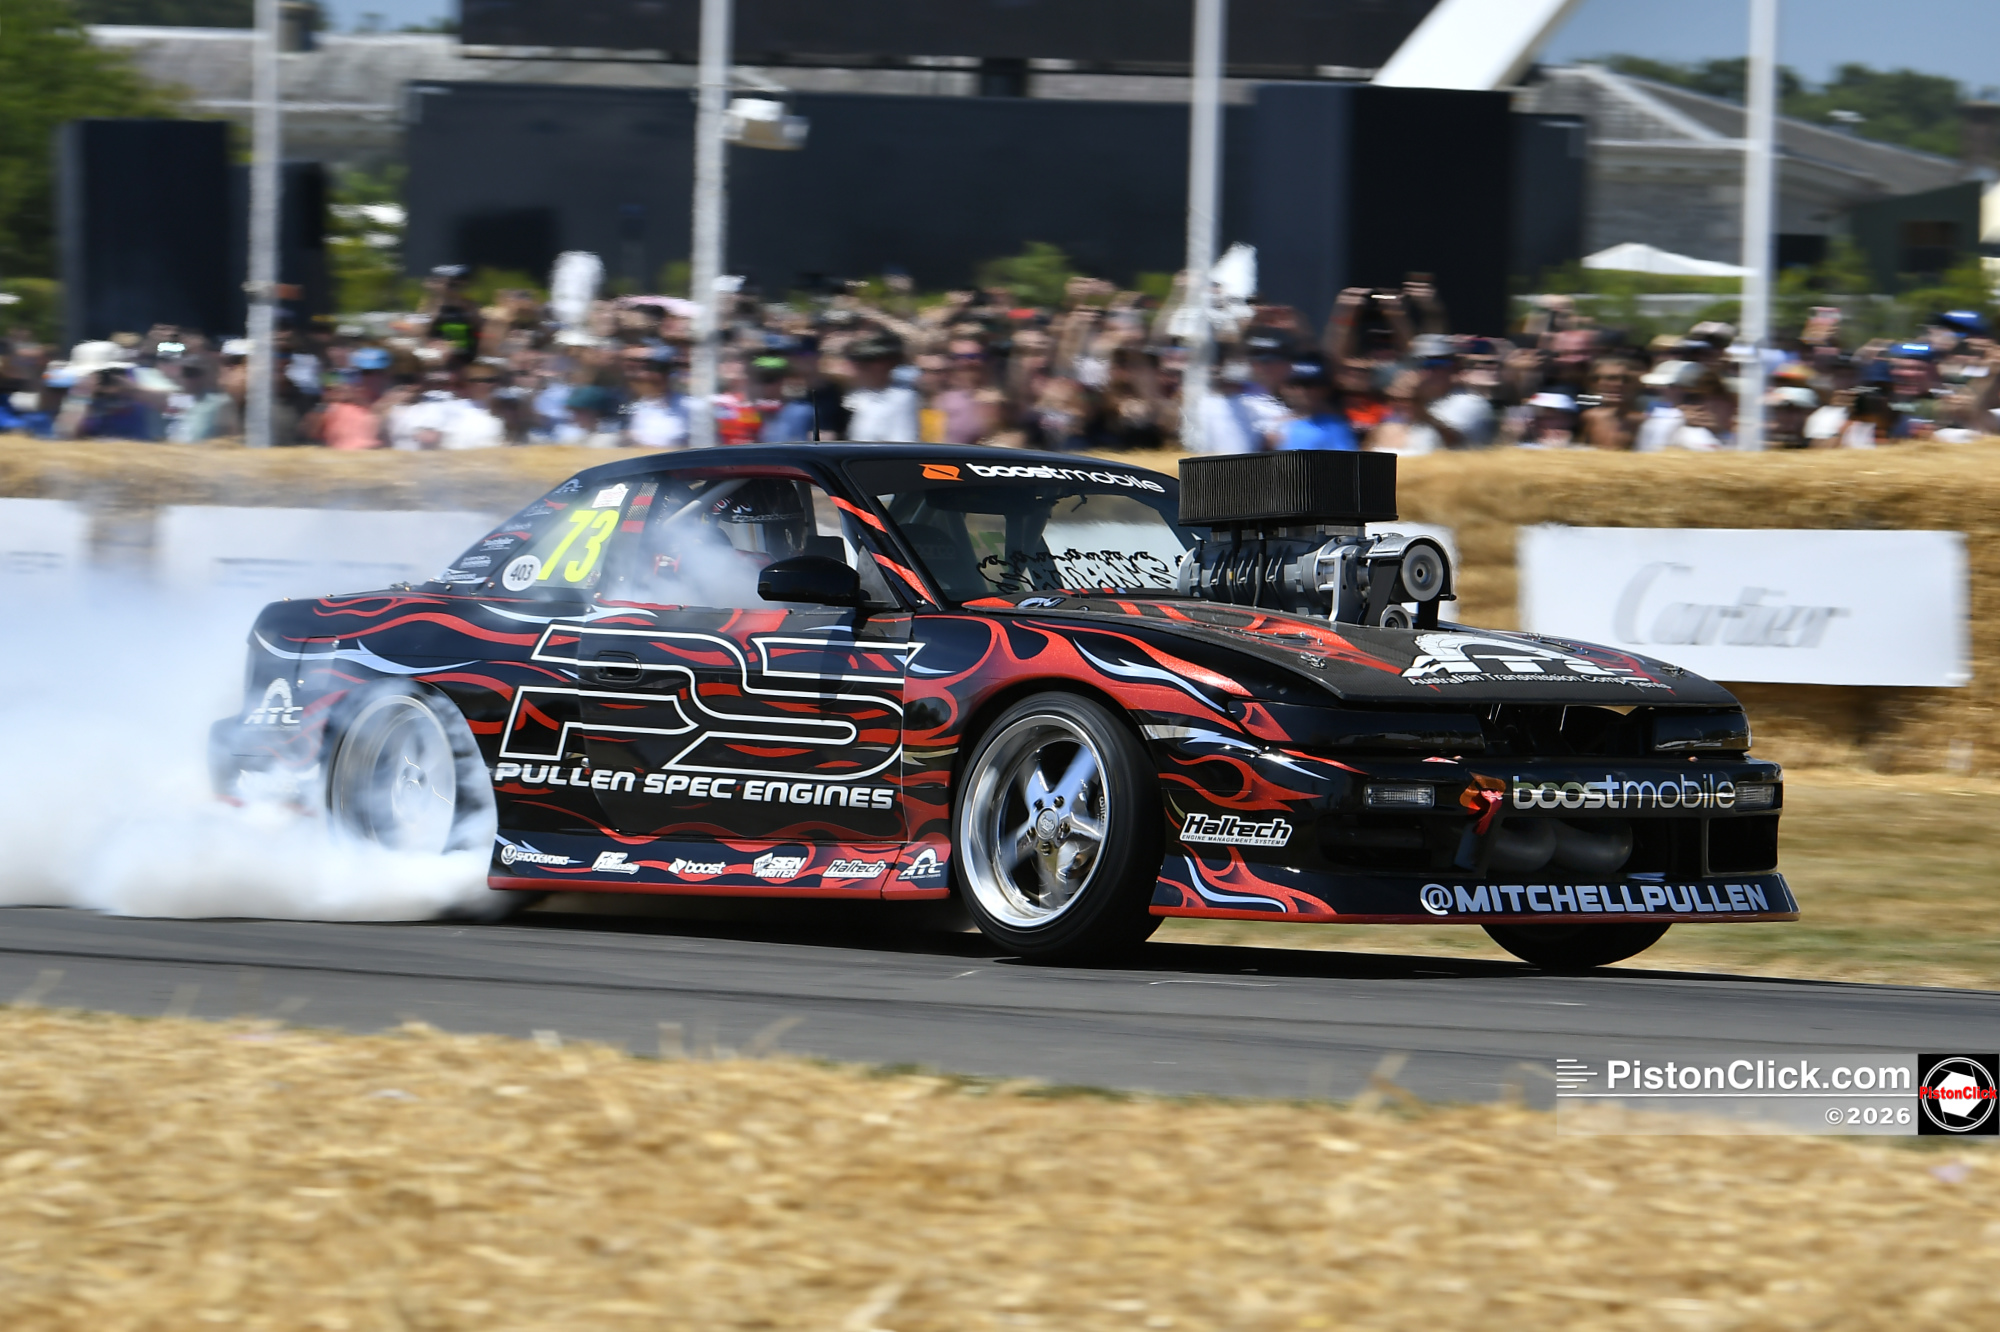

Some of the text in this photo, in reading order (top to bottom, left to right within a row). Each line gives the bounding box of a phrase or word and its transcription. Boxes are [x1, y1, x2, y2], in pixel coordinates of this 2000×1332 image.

[965, 463, 1166, 493] boostmobile
[536, 509, 620, 582] 73
[510, 564, 534, 582] 403
[1407, 672, 1486, 687] Australian
[1480, 672, 1578, 685] Transmission
[495, 761, 894, 810] PULLEN SPEC ENGINES
[1513, 774, 1736, 810] boostmobile
[1184, 815, 1291, 839] Haltech
[1207, 836, 1253, 844] MANAGEMENT
[684, 860, 727, 875] boost
[755, 869, 799, 878] WRITER
[827, 860, 887, 873] Haltech
[1420, 883, 1770, 916] @MITCHELLPULLEN
